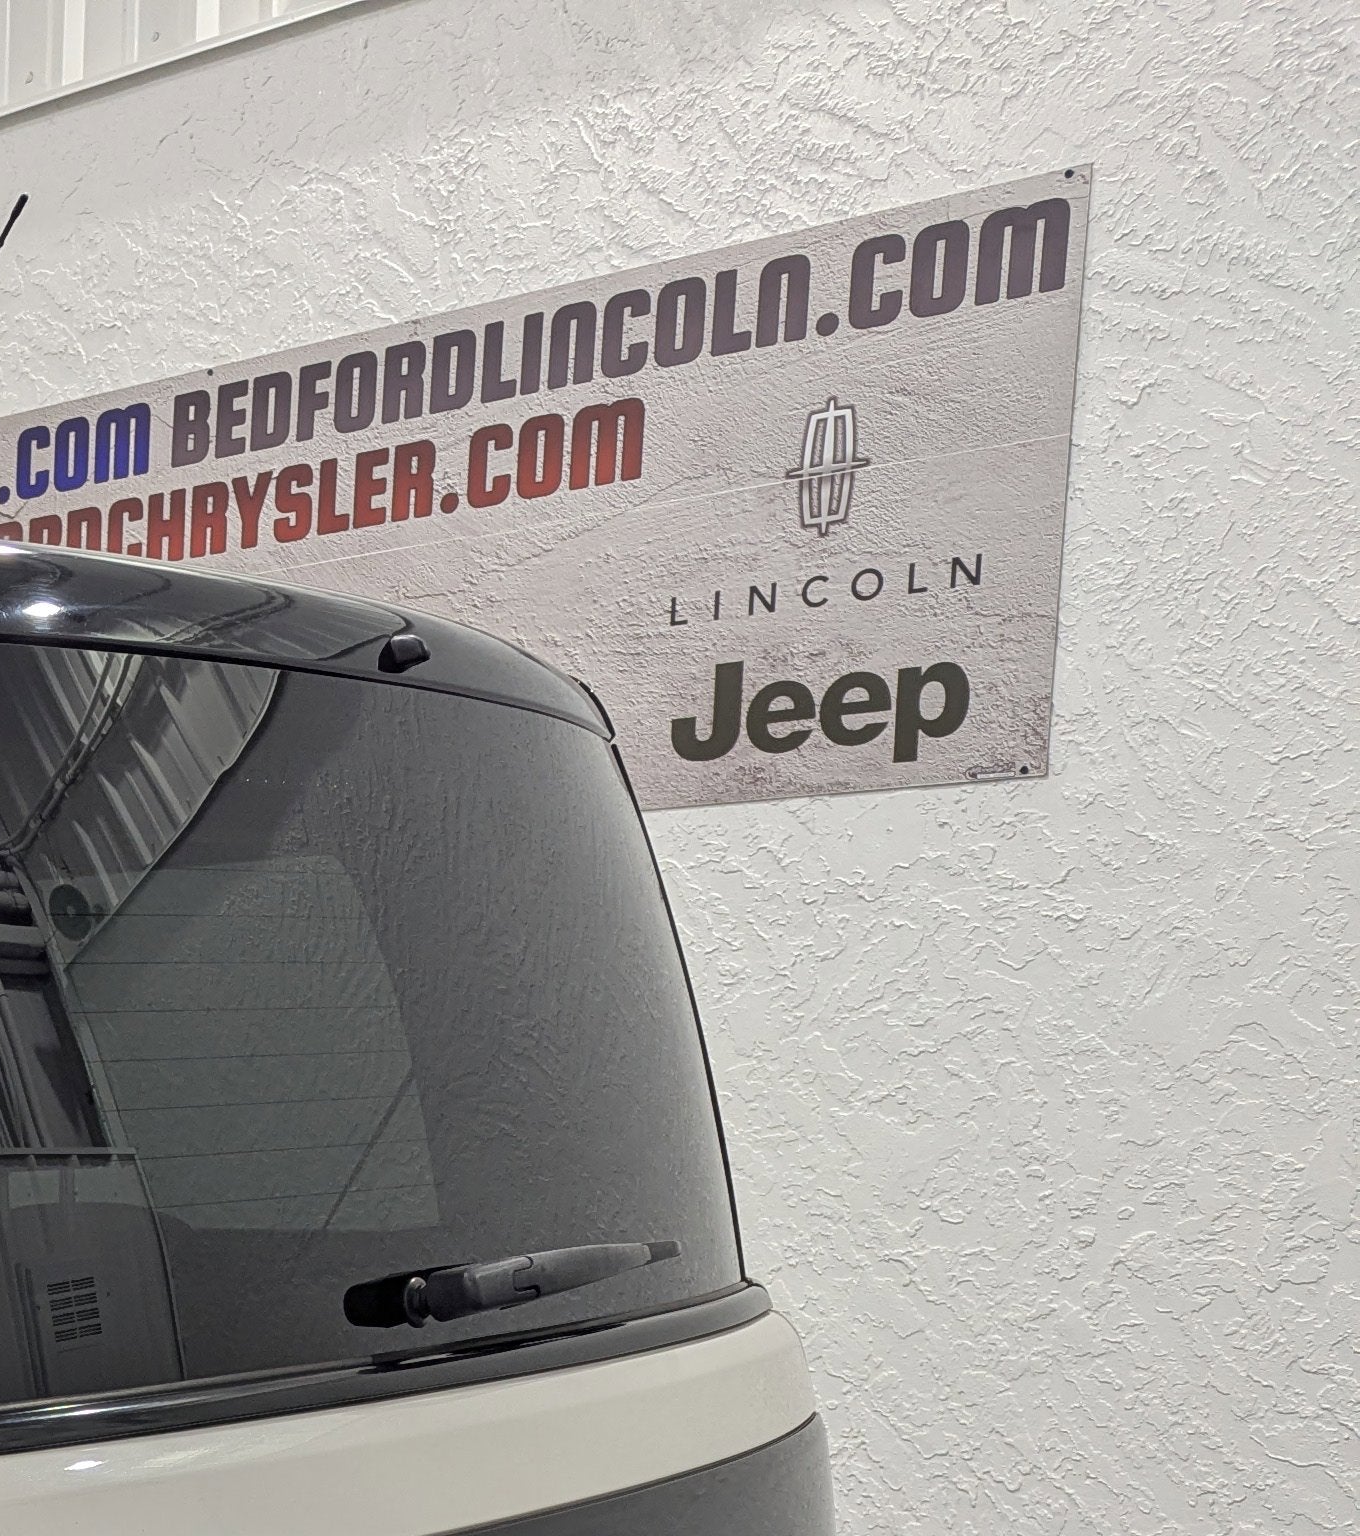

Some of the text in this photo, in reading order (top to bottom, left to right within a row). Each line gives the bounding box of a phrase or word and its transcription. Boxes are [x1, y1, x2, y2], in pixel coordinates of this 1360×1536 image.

[171, 197, 1071, 468] BEDFORDLINCOLN.COM
[670, 554, 982, 626] LINCOLN
[671, 660, 970, 763] Jeep
